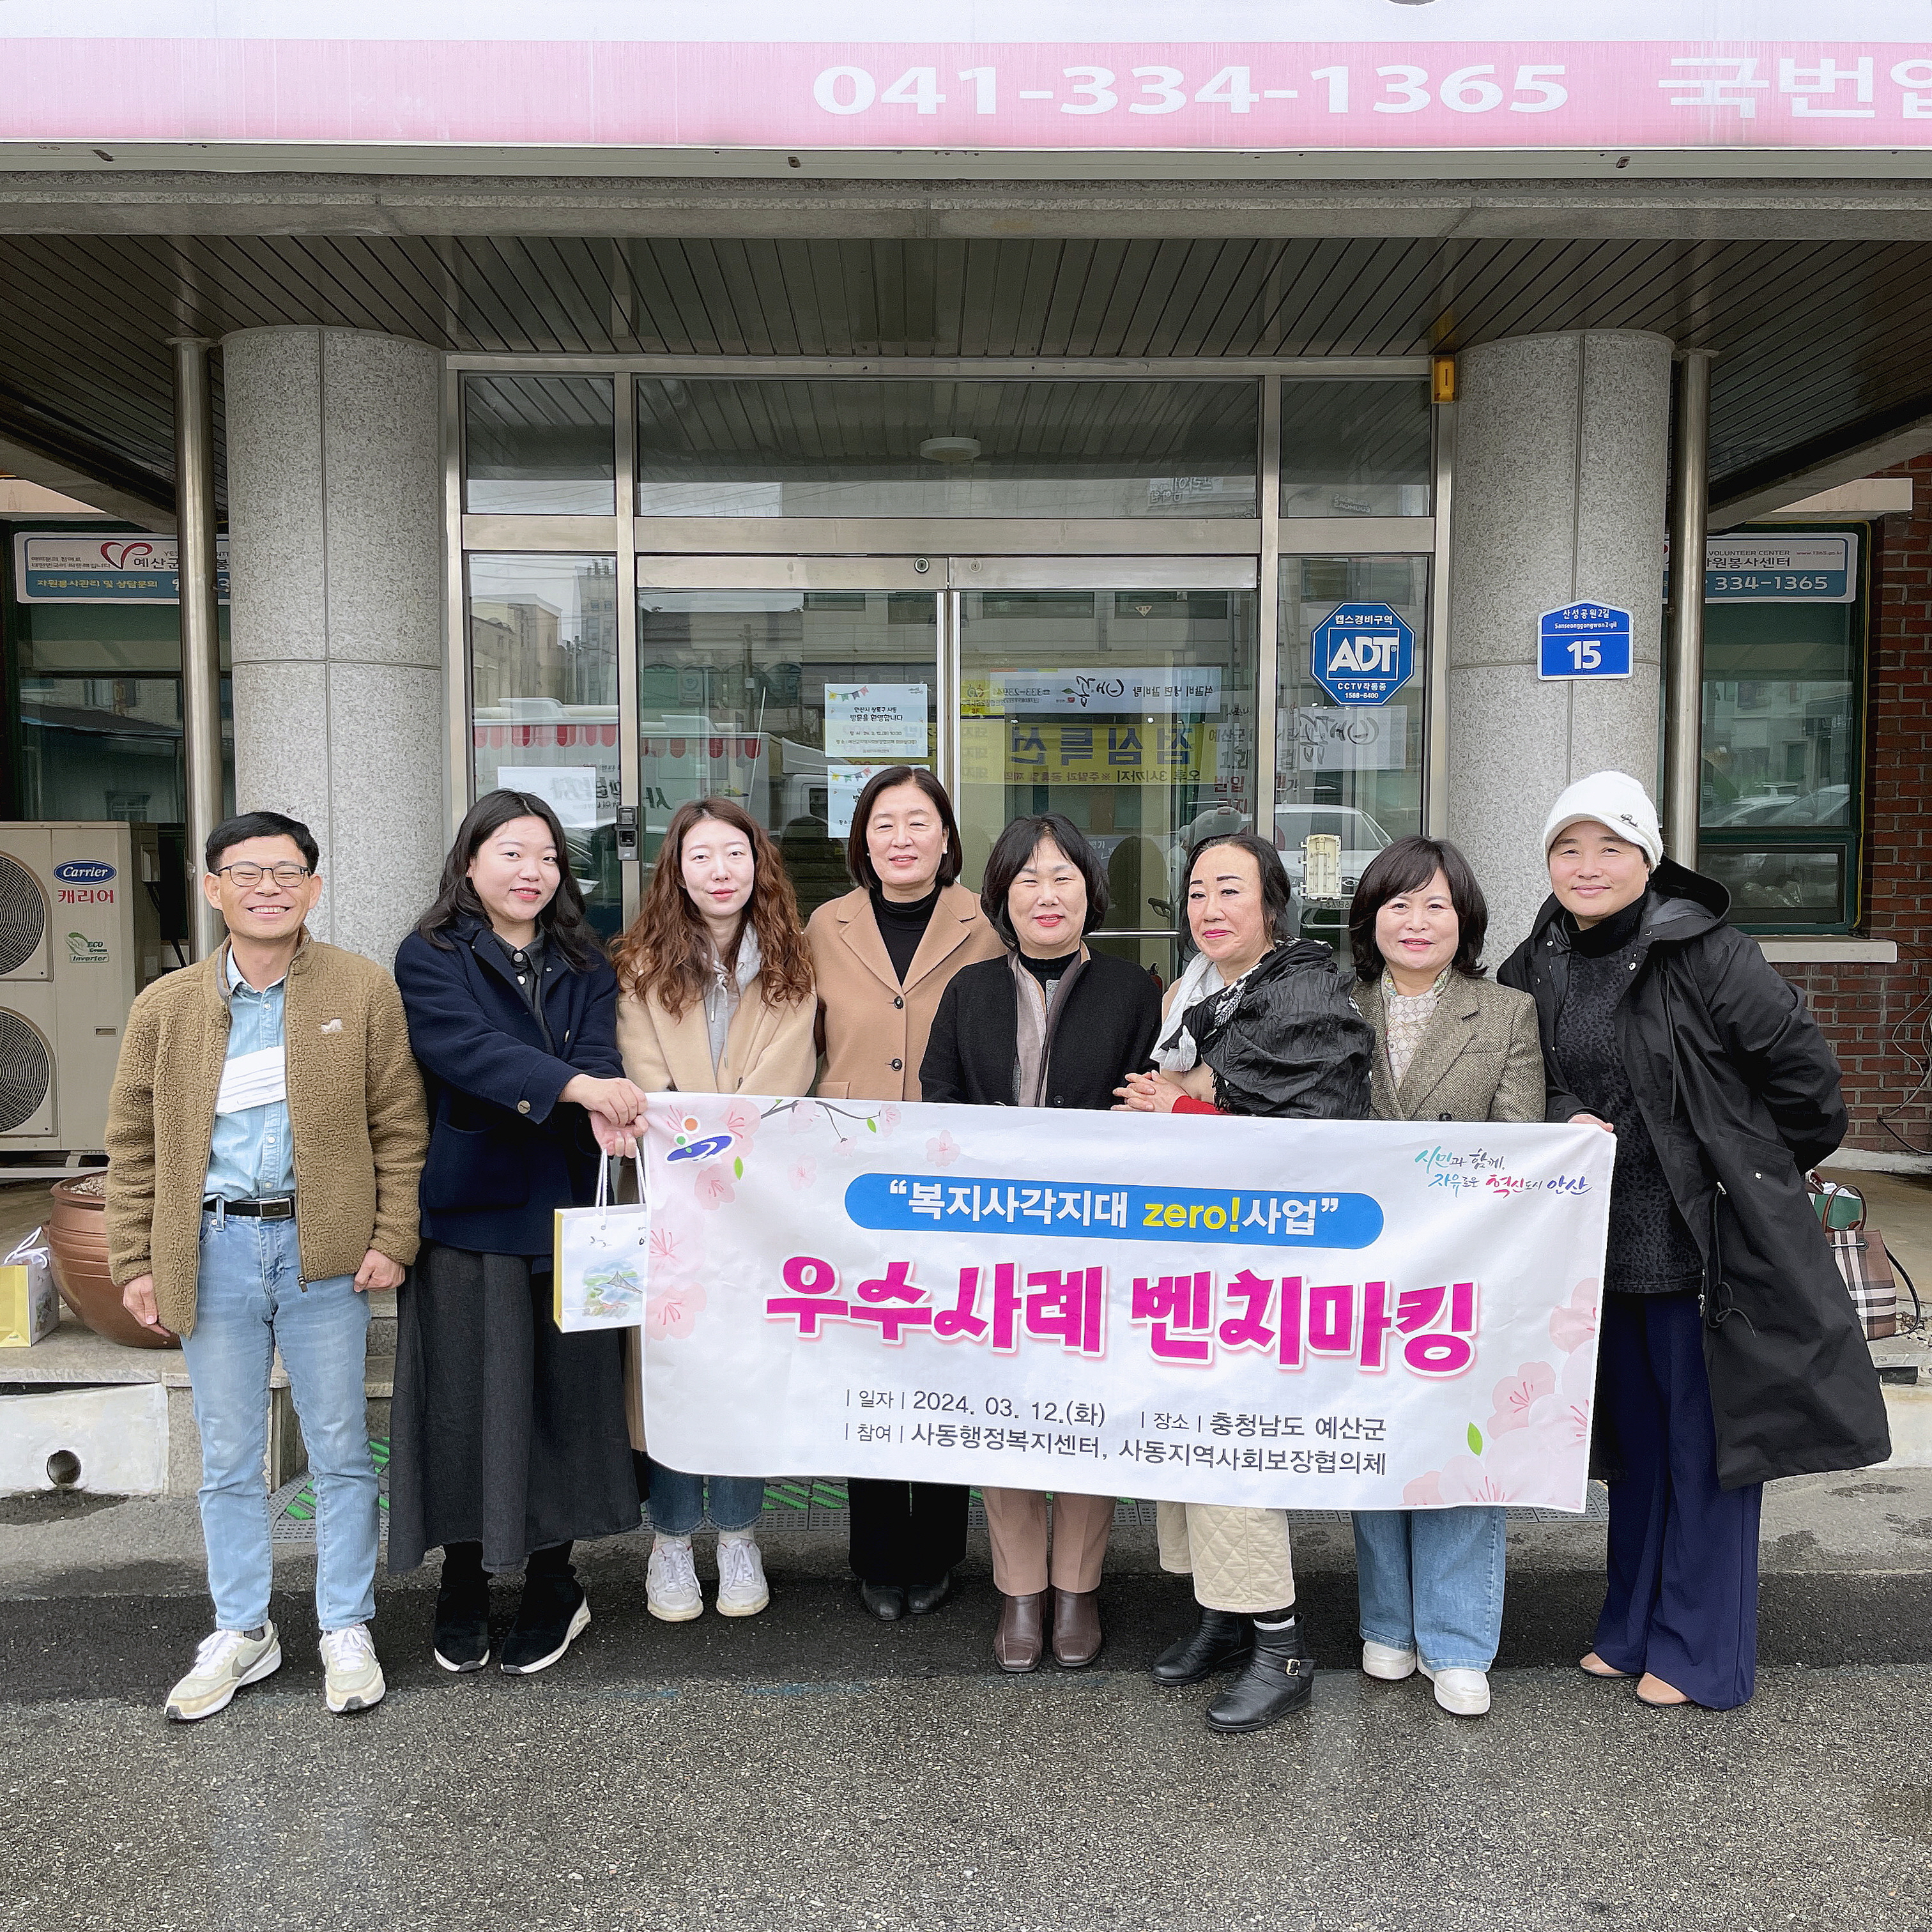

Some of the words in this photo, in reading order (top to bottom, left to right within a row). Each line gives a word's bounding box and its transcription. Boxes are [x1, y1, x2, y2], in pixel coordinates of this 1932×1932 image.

[812, 65, 1568, 115] 041-334-1365
[1714, 576, 1828, 590] 334-1365
[1335, 615, 1393, 625] 캡스경비구역
[1562, 608, 1610, 620] 산성공원2길
[1328, 636, 1399, 672] ADT
[1566, 640, 1602, 670] 15
[63, 866, 109, 878] Carrier
[57, 889, 114, 904] 캐리어
[1414, 1145, 1468, 1174] 시민과
[1427, 1173, 1480, 1198] 자유로운
[1485, 1174, 1544, 1199] 혁신도시
[1547, 1175, 1593, 1195] 안산
[765, 1255, 1106, 1353] 우수사례
[1130, 1268, 1478, 1377] 벤치마킹
[859, 1390, 894, 1409] 일자
[912, 1390, 975, 1415] 2024.
[985, 1397, 1019, 1419] 03.
[1031, 1401, 1106, 1428] 12.(화)
[1152, 1411, 1190, 1430] 장소
[1209, 1412, 1305, 1437] 충청남도
[1315, 1415, 1386, 1441] 예산군
[857, 1423, 891, 1443] 참여
[911, 1422, 1108, 1460] 사동행정복지센터,
[1119, 1439, 1386, 1476] 사동지역사회보장협의체
